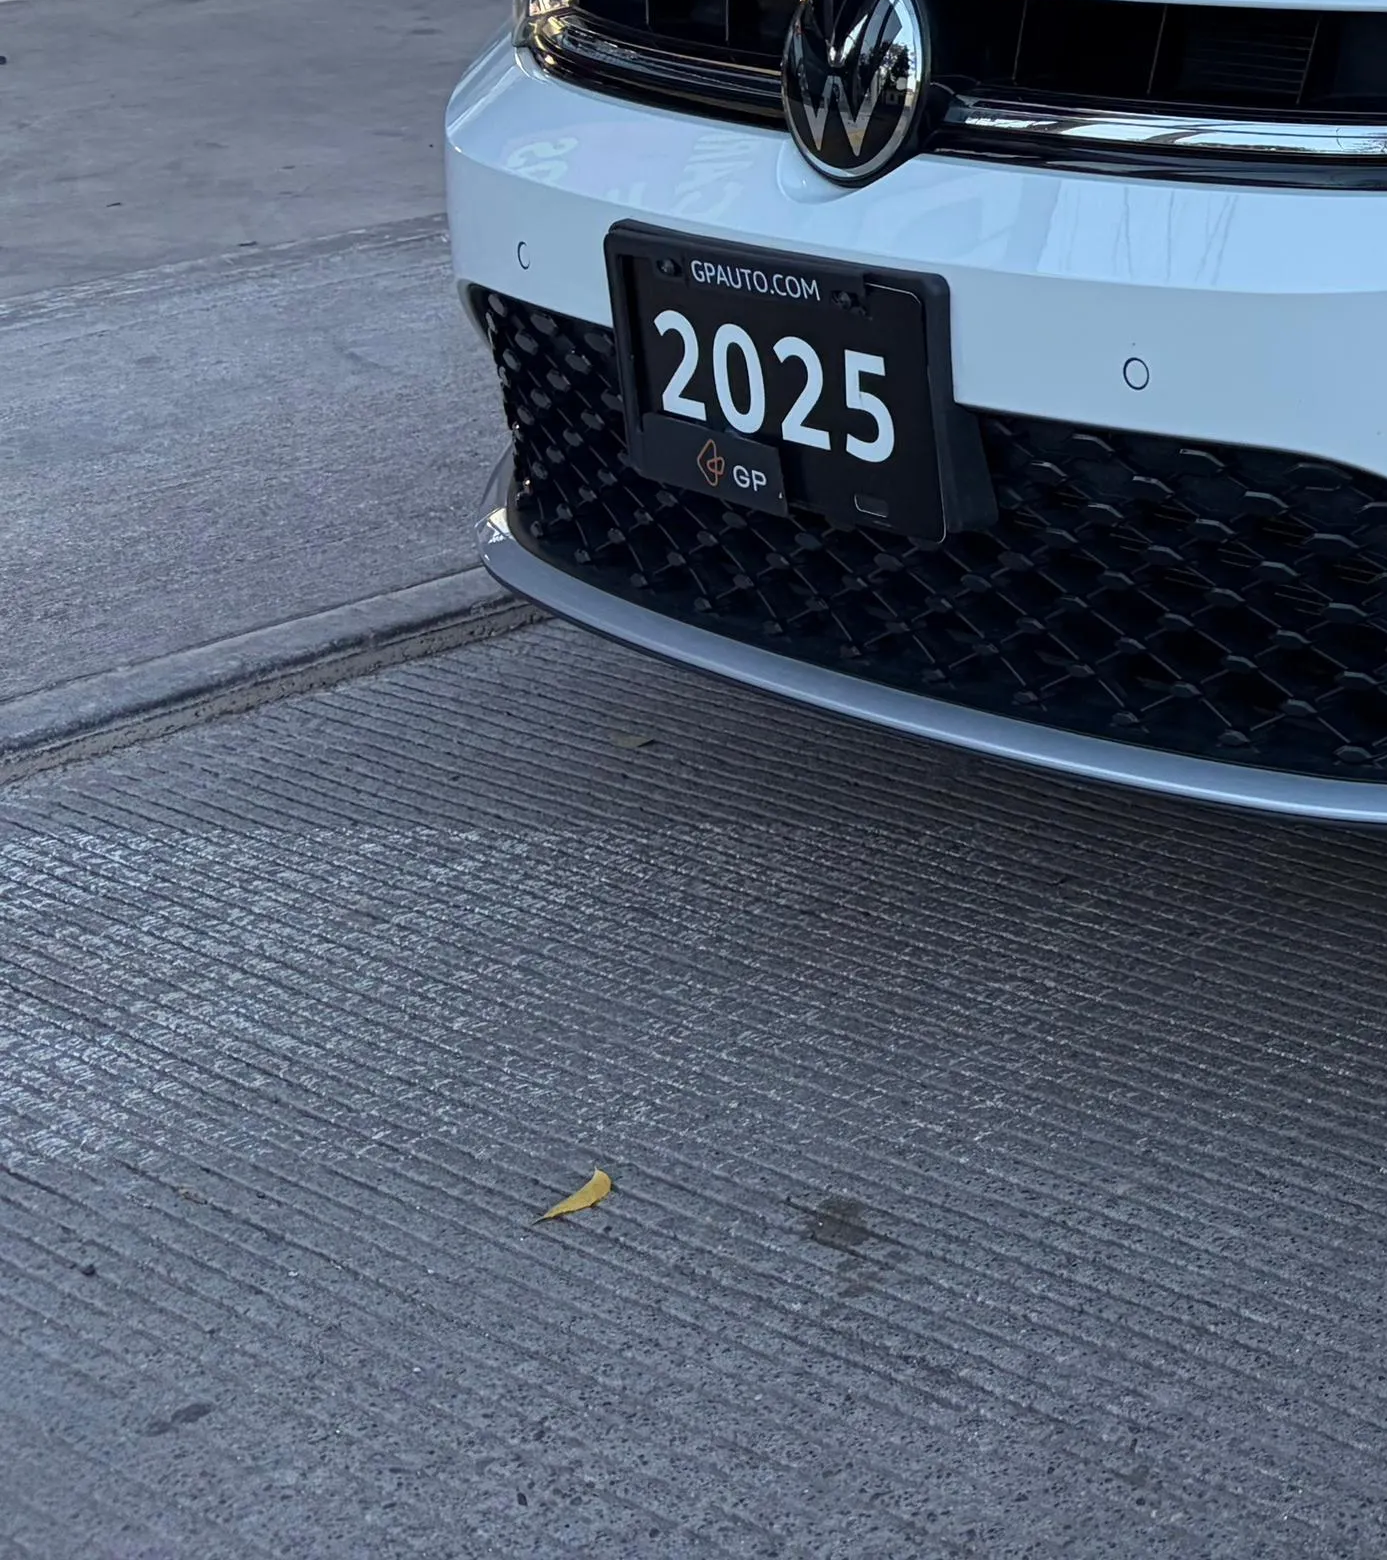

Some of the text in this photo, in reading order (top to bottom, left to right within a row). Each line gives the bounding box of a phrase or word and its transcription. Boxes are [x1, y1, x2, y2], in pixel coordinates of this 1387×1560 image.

[690, 260, 821, 302] GPAUTO.COM
[653, 309, 895, 463] 2025
[733, 465, 767, 492] GP
